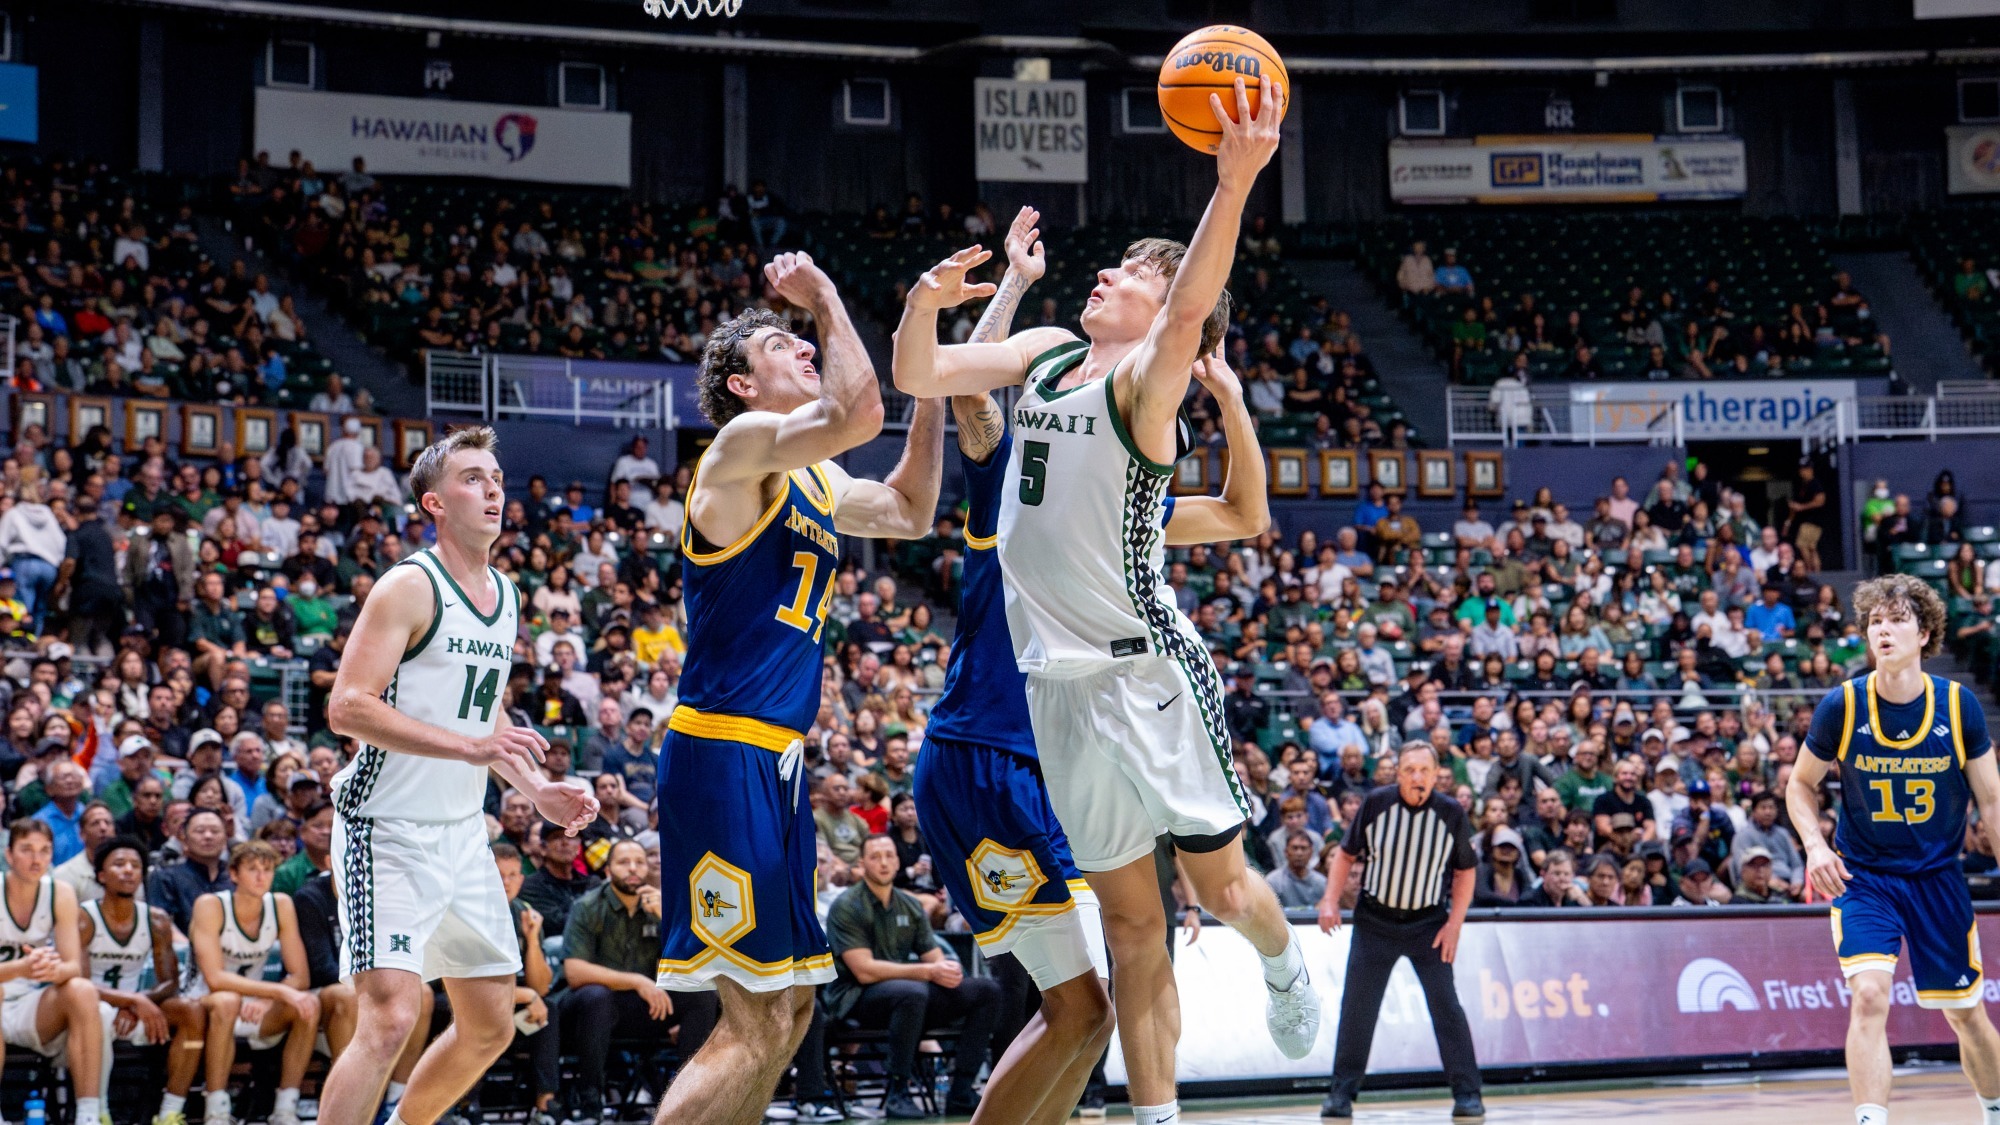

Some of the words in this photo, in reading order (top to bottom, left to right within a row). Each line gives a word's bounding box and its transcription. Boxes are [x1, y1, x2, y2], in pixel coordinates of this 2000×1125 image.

[424, 67, 453, 89] PP
[1175, 51, 1261, 78] Wilson
[985, 87, 1077, 118] ISLAND
[1545, 106, 1574, 127] RR
[351, 116, 487, 144] HAWAIIAN
[980, 122, 1084, 152] MOVERS
[1500, 160, 1534, 179] GP
[1548, 152, 1643, 172] Roadway
[1014, 409, 1098, 436] AWAI'I
[1019, 440, 1050, 506] 5
[775, 551, 836, 645] 14
[457, 664, 500, 722] 14
[1854, 754, 1952, 774] ANTEATERS
[1869, 779, 1936, 825] 13
[103, 965, 122, 989] 4
[1479, 968, 1610, 1020] best.
[1763, 979, 1835, 1010] First
